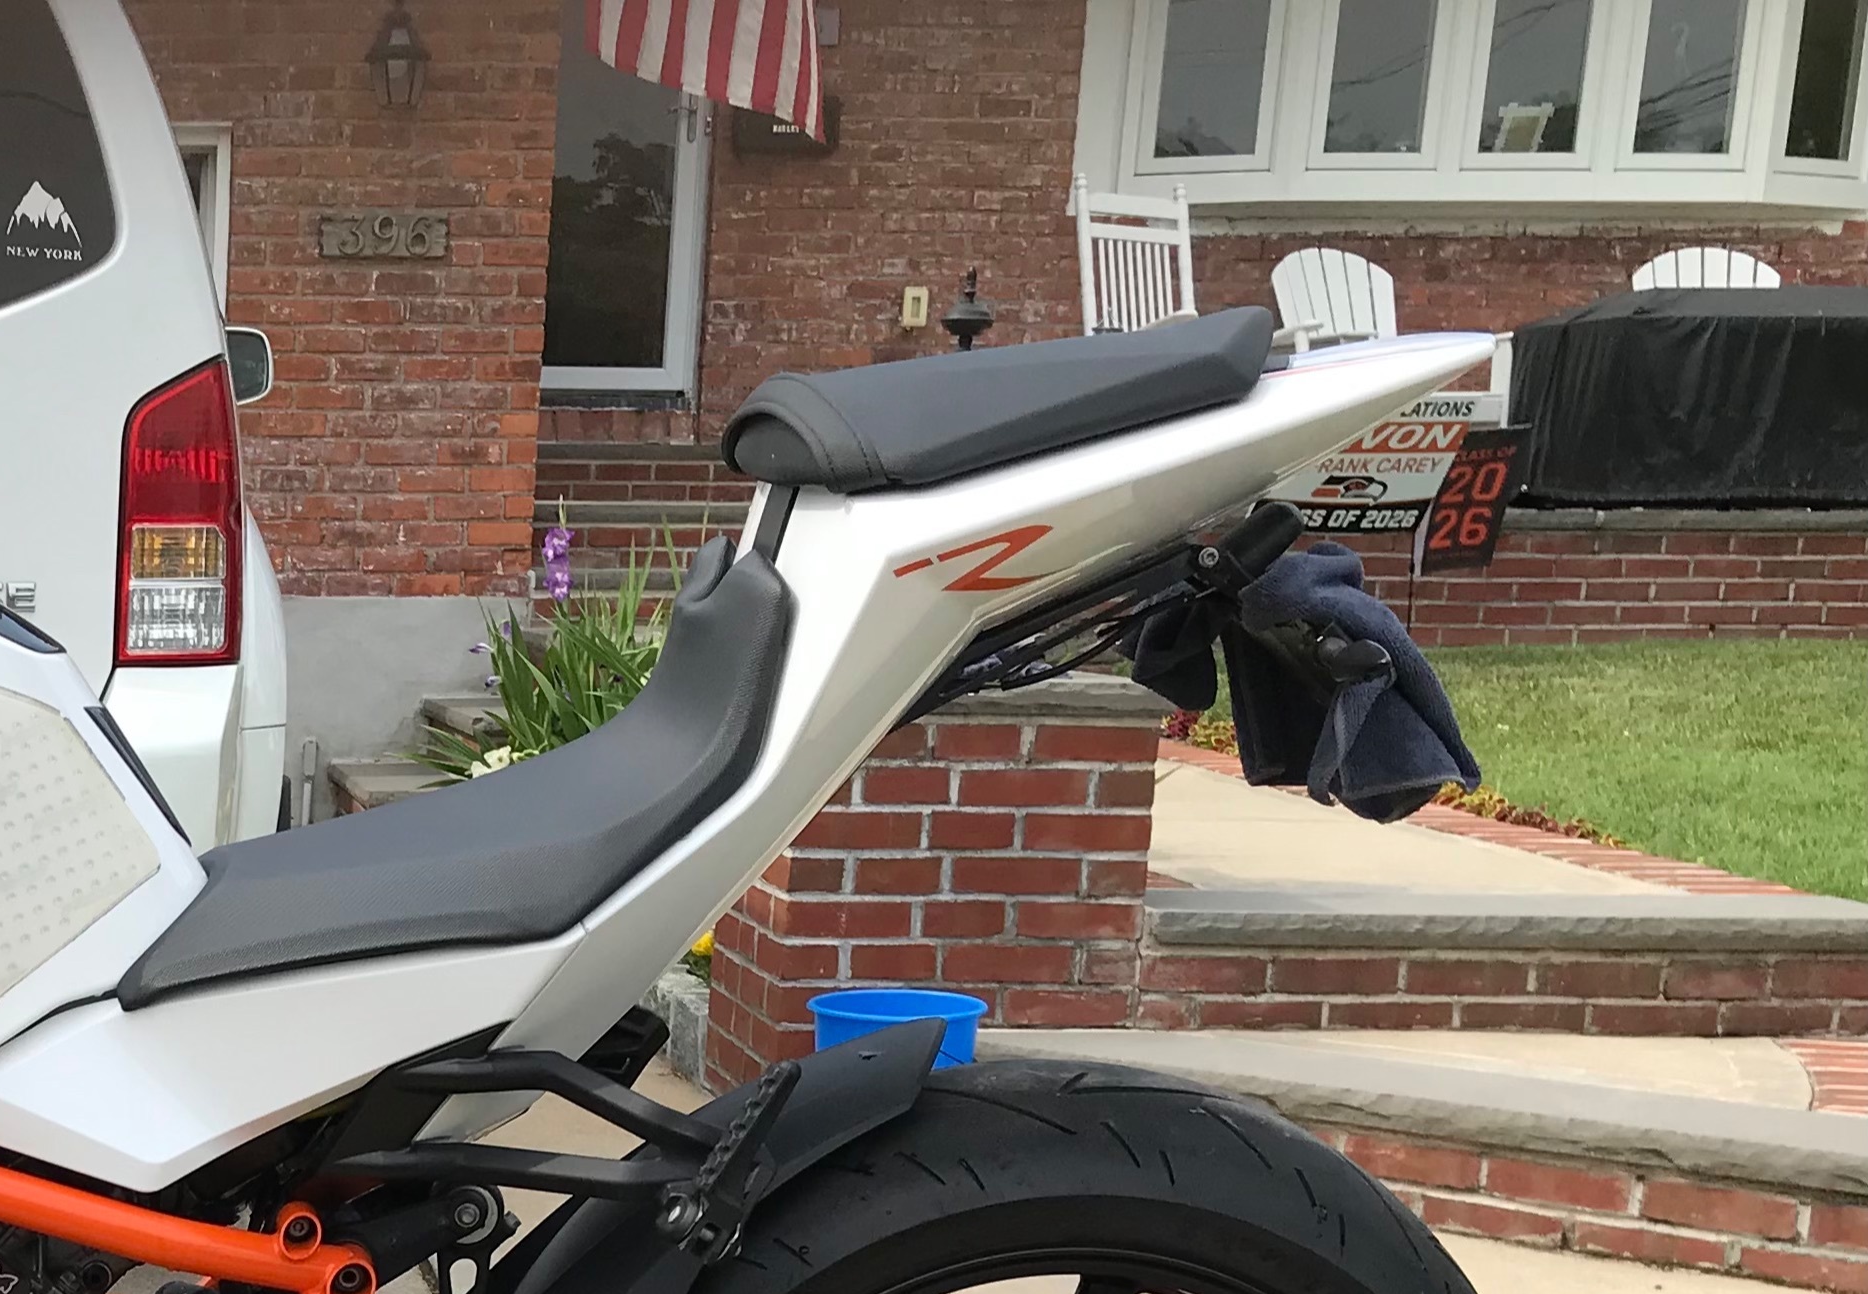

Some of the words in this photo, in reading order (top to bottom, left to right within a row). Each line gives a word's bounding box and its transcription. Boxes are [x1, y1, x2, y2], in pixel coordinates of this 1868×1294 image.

[338, 214, 431, 256] 396
[6, 245, 39, 258] NEW
[43, 247, 83, 261] YORK
[1361, 423, 1461, 450] VON
[1318, 457, 1373, 474] RANK
[1375, 458, 1445, 474] CAREY
[1441, 462, 1509, 504] 20
[1327, 510, 1358, 528] OF
[1359, 509, 1420, 529] 2026
[1429, 507, 1493, 549] 26
